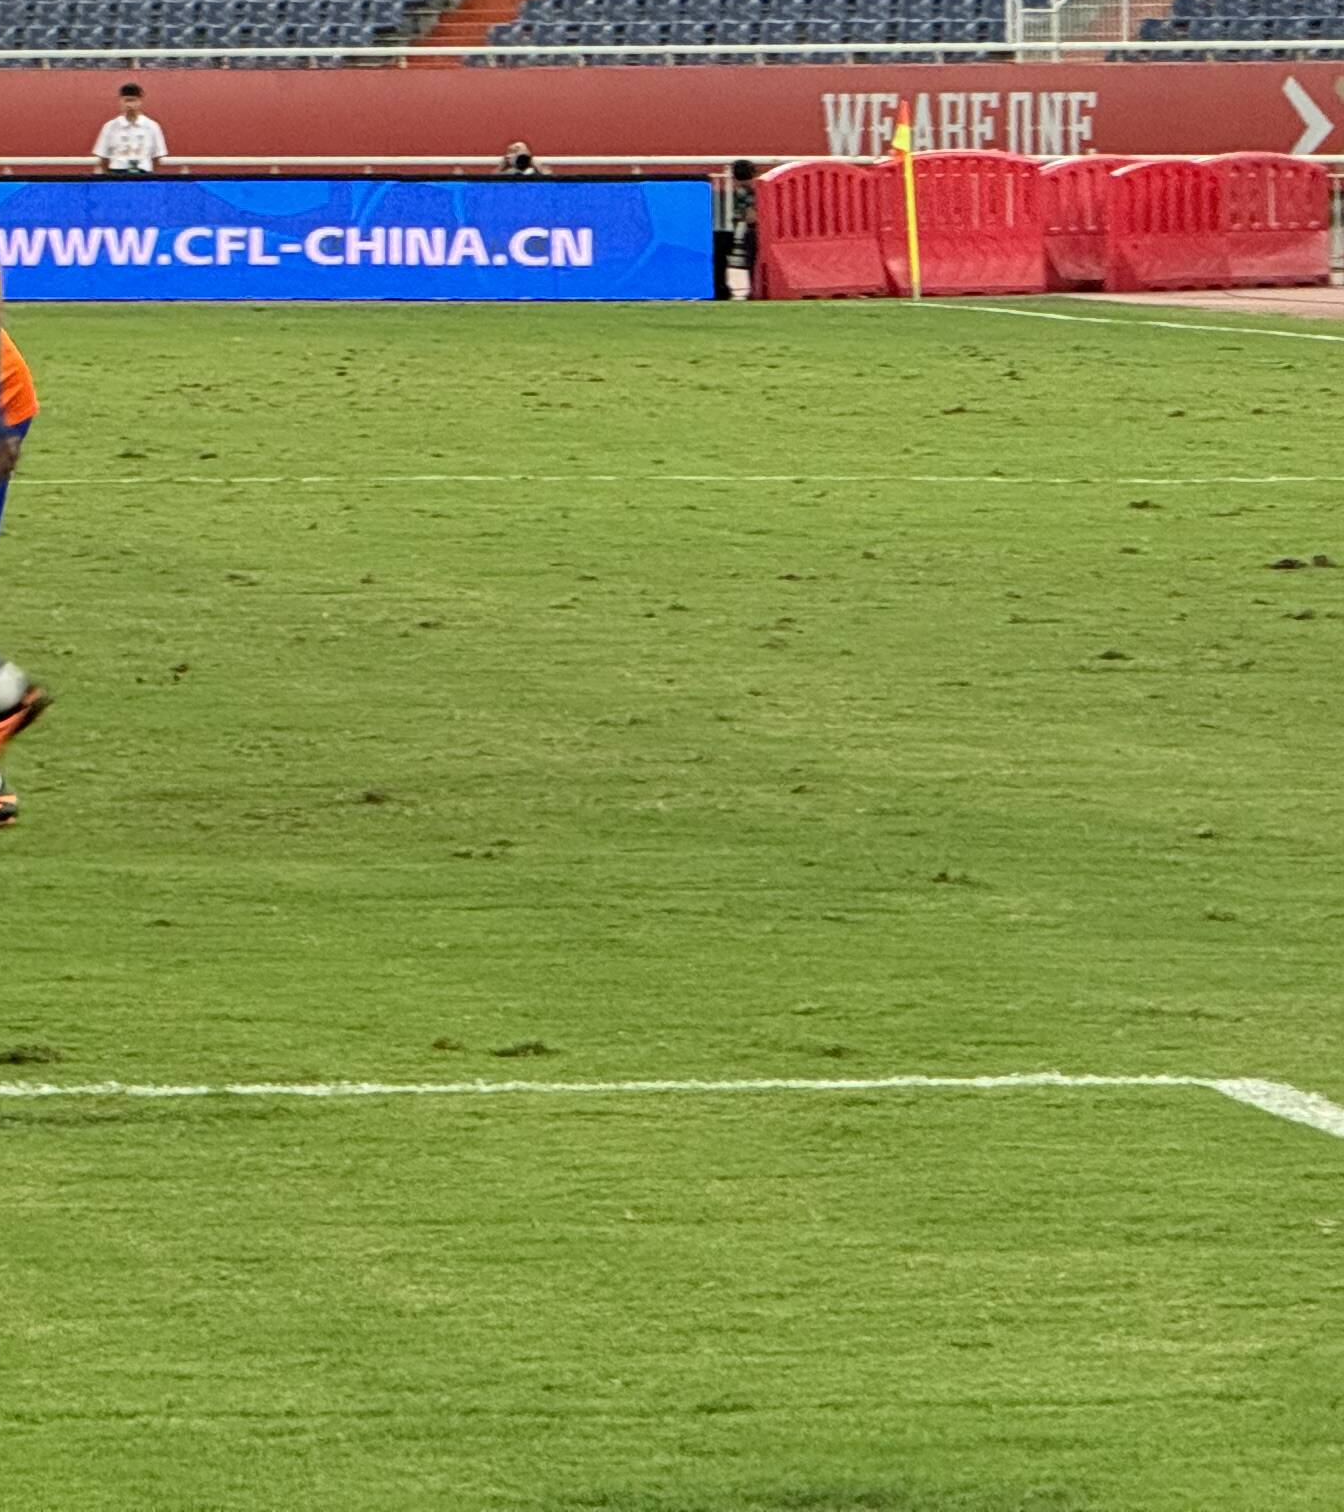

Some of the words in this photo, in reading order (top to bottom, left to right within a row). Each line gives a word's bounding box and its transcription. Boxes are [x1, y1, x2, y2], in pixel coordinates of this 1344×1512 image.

[820, 92, 900, 156] WE
[914, 91, 1001, 150] ARE
[1008, 91, 1098, 156] ONE
